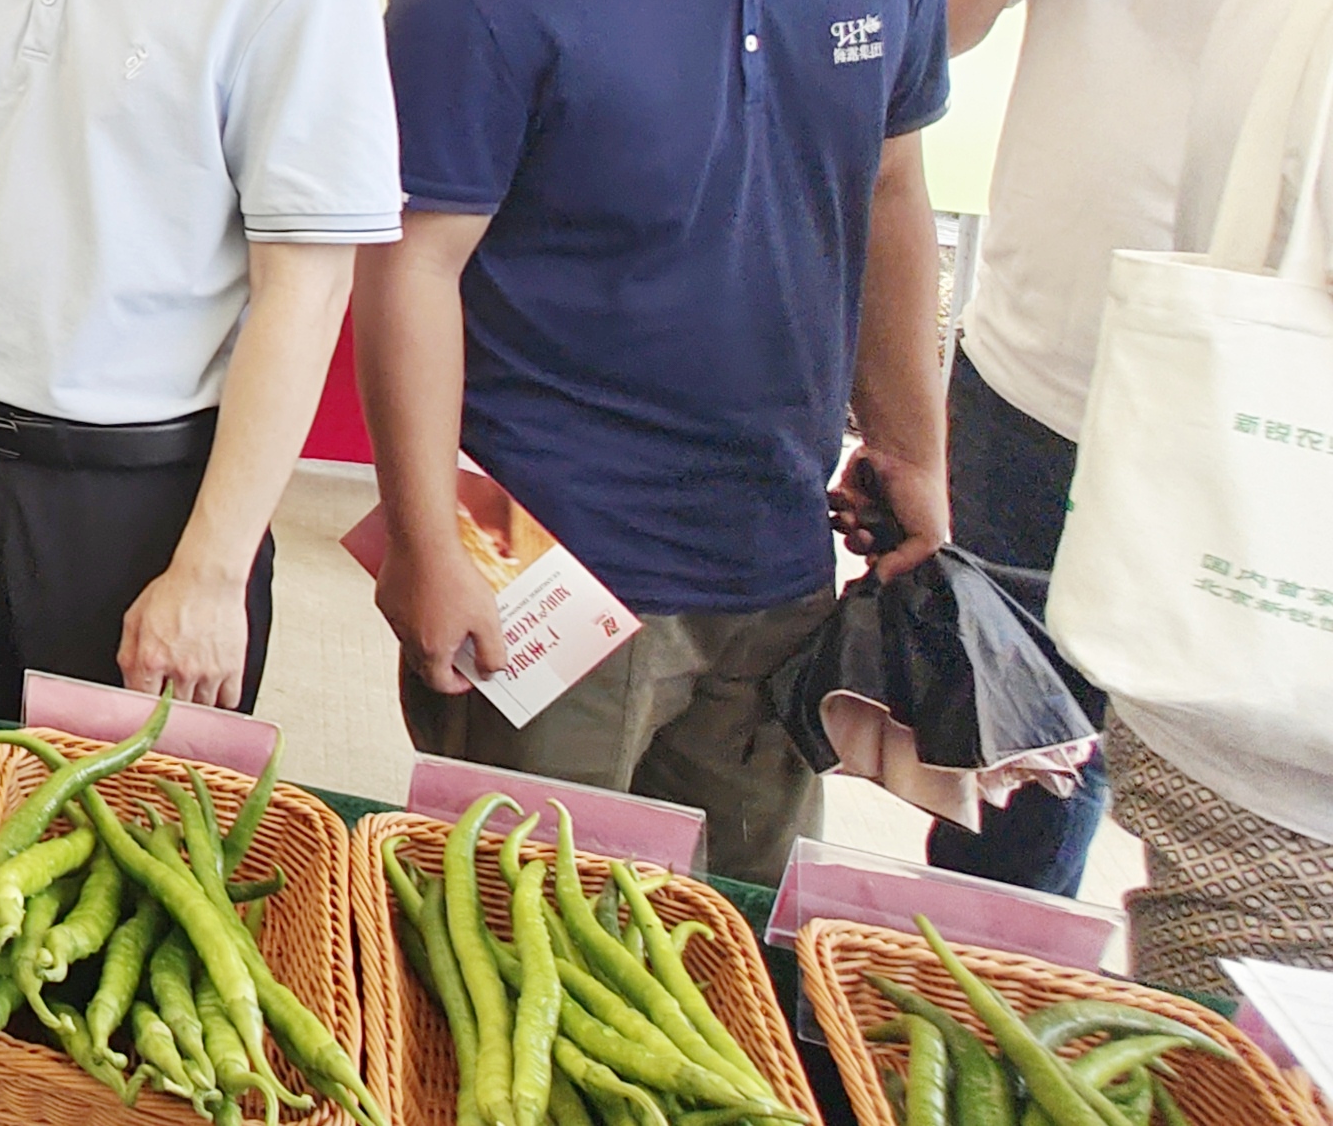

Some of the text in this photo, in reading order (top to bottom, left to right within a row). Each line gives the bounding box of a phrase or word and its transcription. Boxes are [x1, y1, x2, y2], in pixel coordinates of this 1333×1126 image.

[1234, 412, 1333, 456] 新锐农
[503, 583, 572, 648] 知识产权有限
